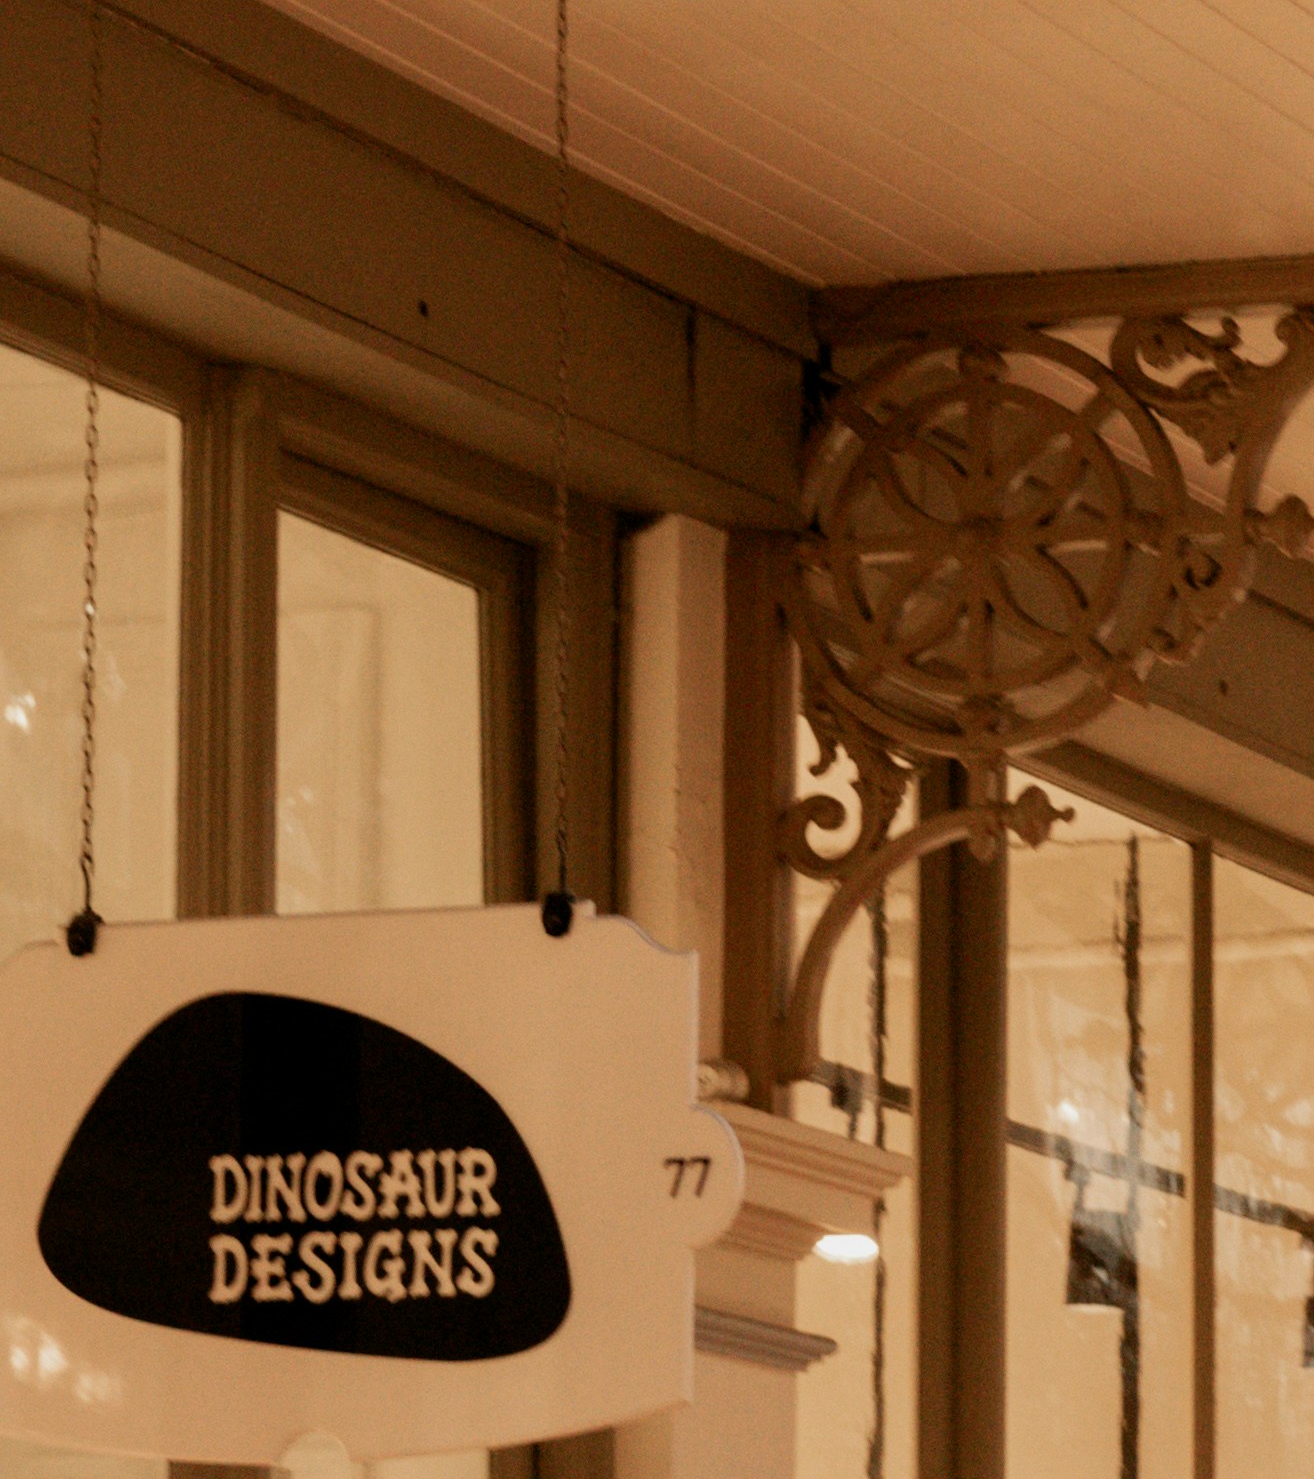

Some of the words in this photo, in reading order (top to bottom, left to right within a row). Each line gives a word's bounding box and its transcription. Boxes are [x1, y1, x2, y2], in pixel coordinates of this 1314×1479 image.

[208, 1147, 500, 1225] DINOSAUR
[664, 1157, 712, 1198] 77
[208, 1228, 499, 1305] DESIGNS
